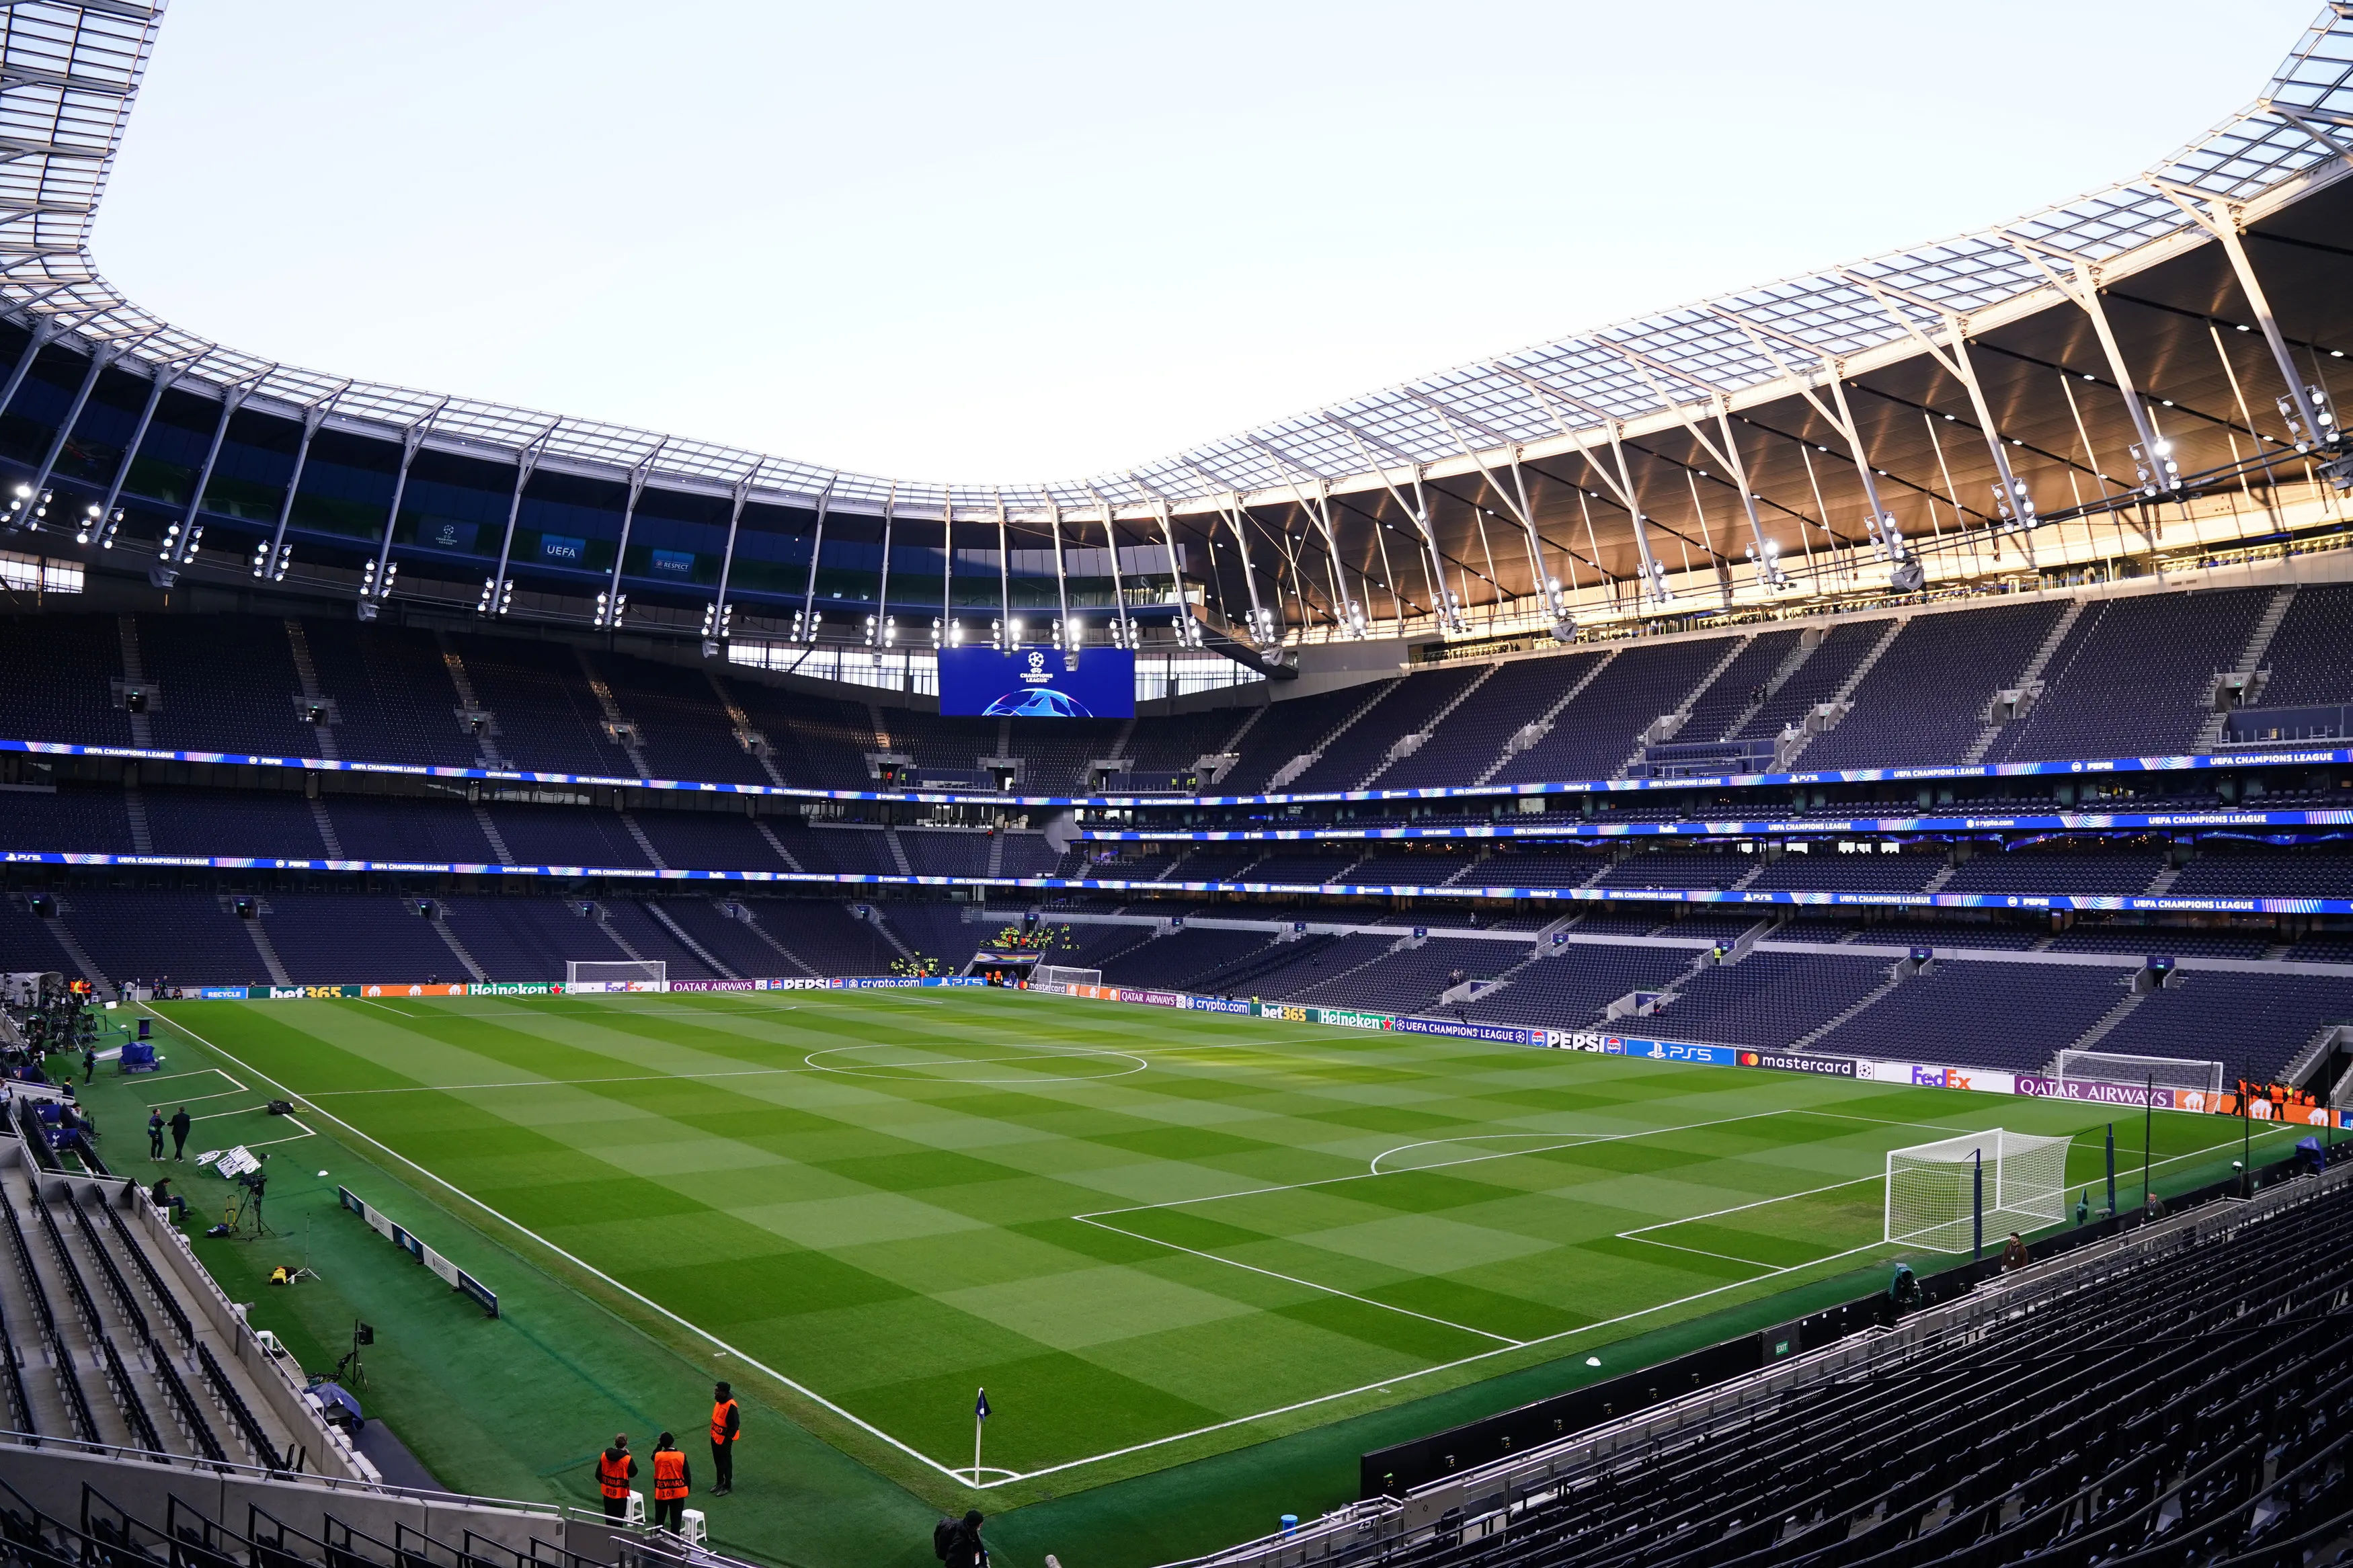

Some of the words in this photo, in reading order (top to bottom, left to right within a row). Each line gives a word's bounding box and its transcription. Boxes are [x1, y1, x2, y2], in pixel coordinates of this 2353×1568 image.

[547, 545, 575, 557] UEFA
[664, 562, 688, 570] RESPECT
[2235, 755, 2292, 764] CHAMPIONS
[2295, 753, 2333, 761] LEAGUE
[1913, 769, 1955, 777] CHAMPIONS
[2159, 901, 2214, 909] CHAMPIONS
[606, 981, 643, 991] FedEx
[674, 983, 707, 991] QATAR
[712, 982, 752, 990] AIRWAYS
[784, 979, 830, 989] PEPSI
[861, 978, 920, 988] crypto.com
[270, 987, 341, 998] bet365
[470, 984, 547, 995] Heineken
[1121, 991, 1143, 1002] QATAR
[1146, 994, 1174, 1005] AIRWAYS
[1197, 999, 1248, 1015] crypto.com
[1261, 1004, 1306, 1022] bet365
[1320, 1009, 1380, 1029] Heineken
[1406, 1022, 1427, 1032] UEFA
[1429, 1024, 1478, 1038] CHAMPIONS
[1480, 1029, 1513, 1041] LEAGUE
[1547, 1032, 1604, 1053] PEPSI
[1670, 1046, 1712, 1061] PS5
[1763, 1056, 1850, 1075] mastercard
[1912, 1065, 1971, 1089] FedEx
[2020, 1079, 2079, 1098] QATAR
[1776, 1343, 1788, 1353] EXIT
[662, 1489, 675, 1497] 167
